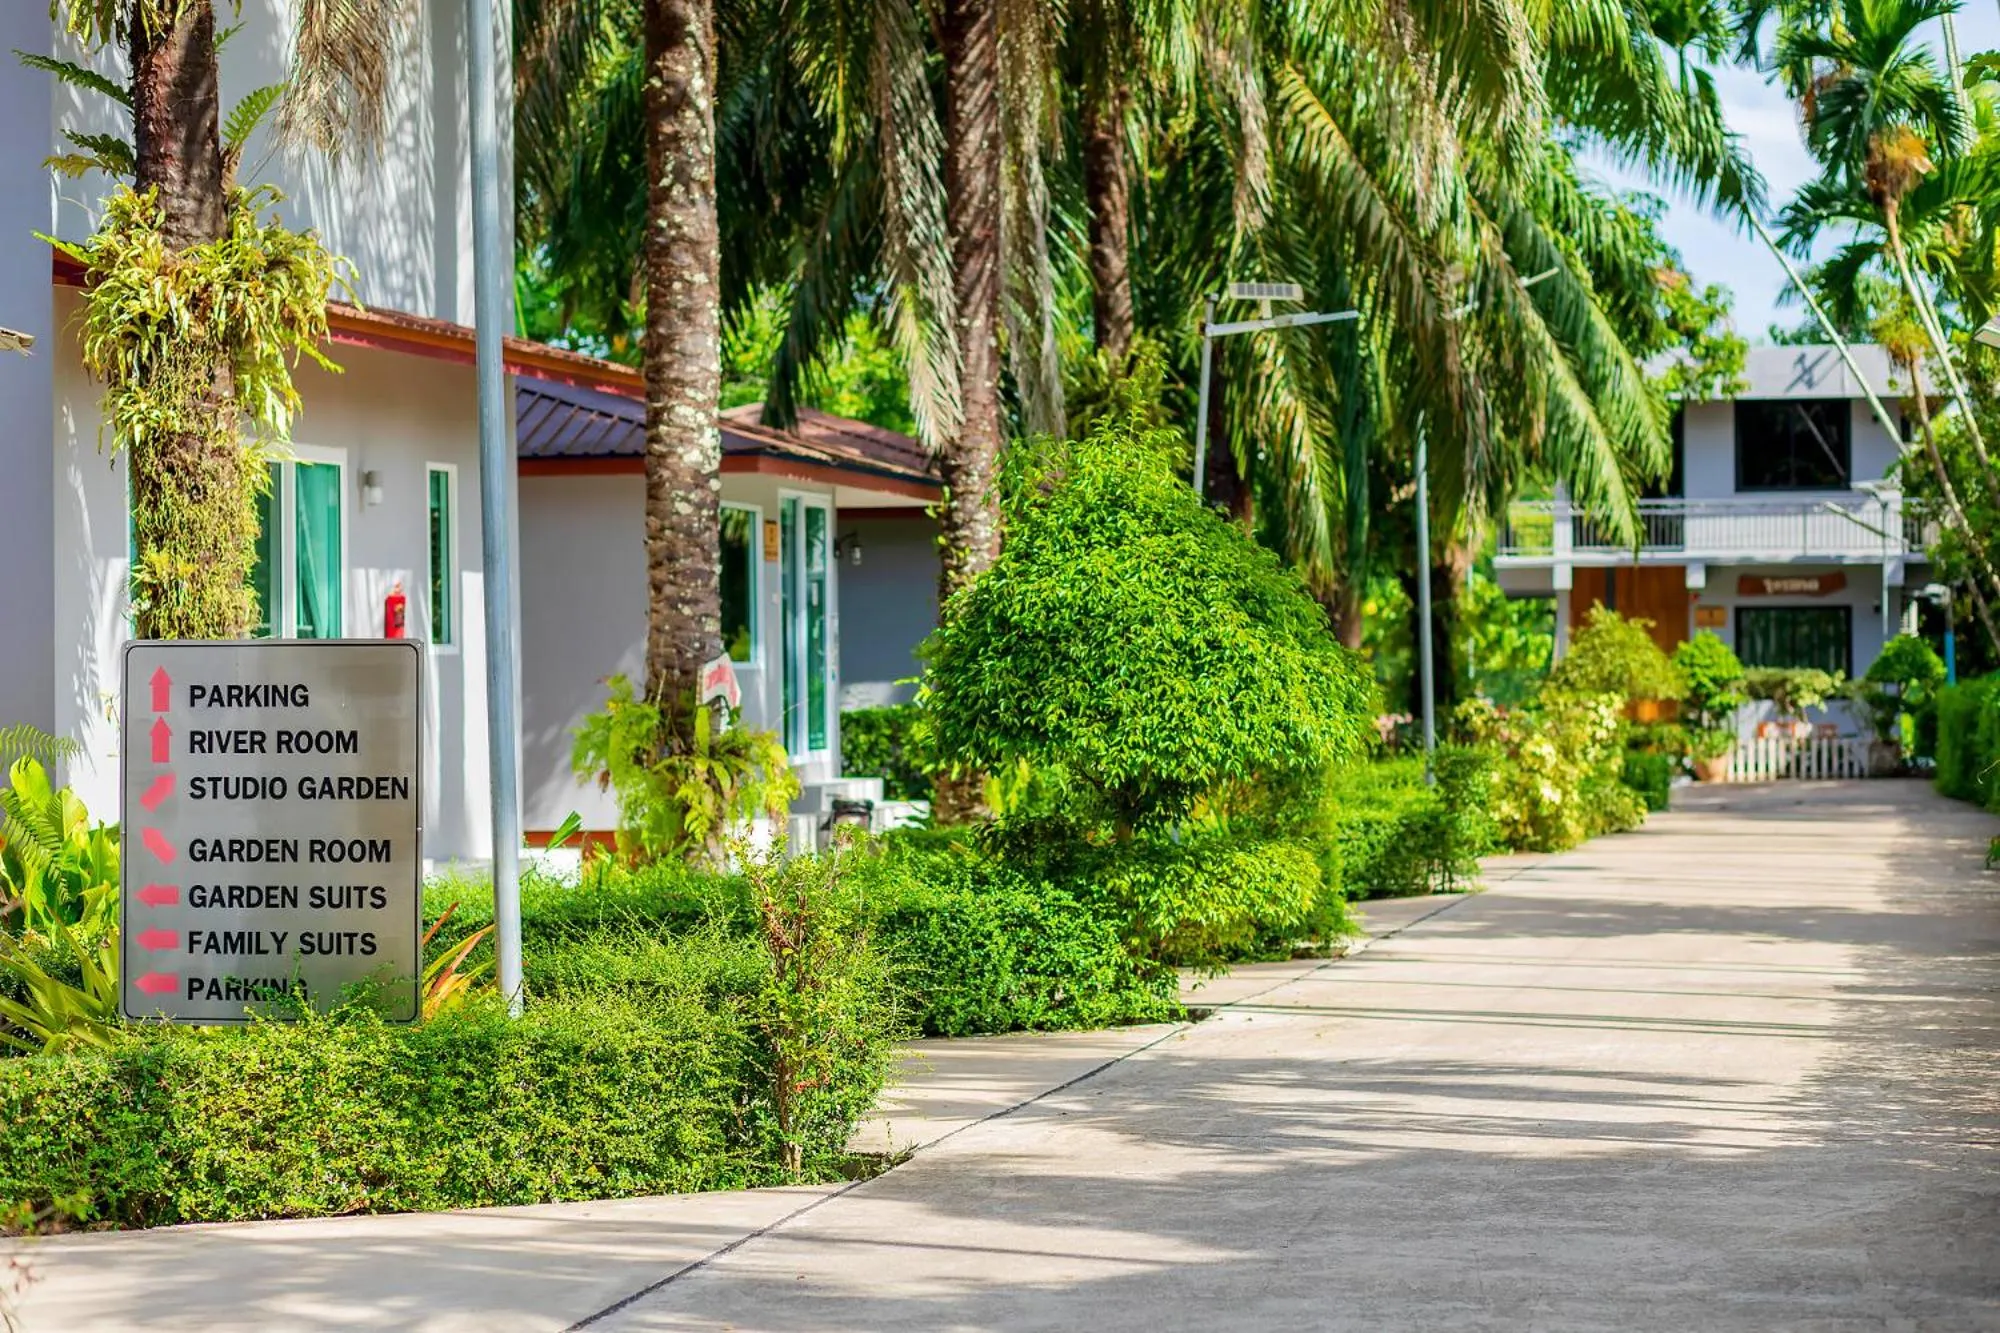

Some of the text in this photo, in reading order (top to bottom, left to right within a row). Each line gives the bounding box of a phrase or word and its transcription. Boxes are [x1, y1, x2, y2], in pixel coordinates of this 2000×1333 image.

[189, 684, 309, 708] PARKING
[189, 730, 358, 754] RIVER ROOM
[189, 776, 409, 800] STUDIO GARDEN
[189, 839, 391, 863] GARDEN ROOM
[189, 885, 387, 909] GARDEN SUITS
[188, 931, 377, 956] FAMILY SUITS
